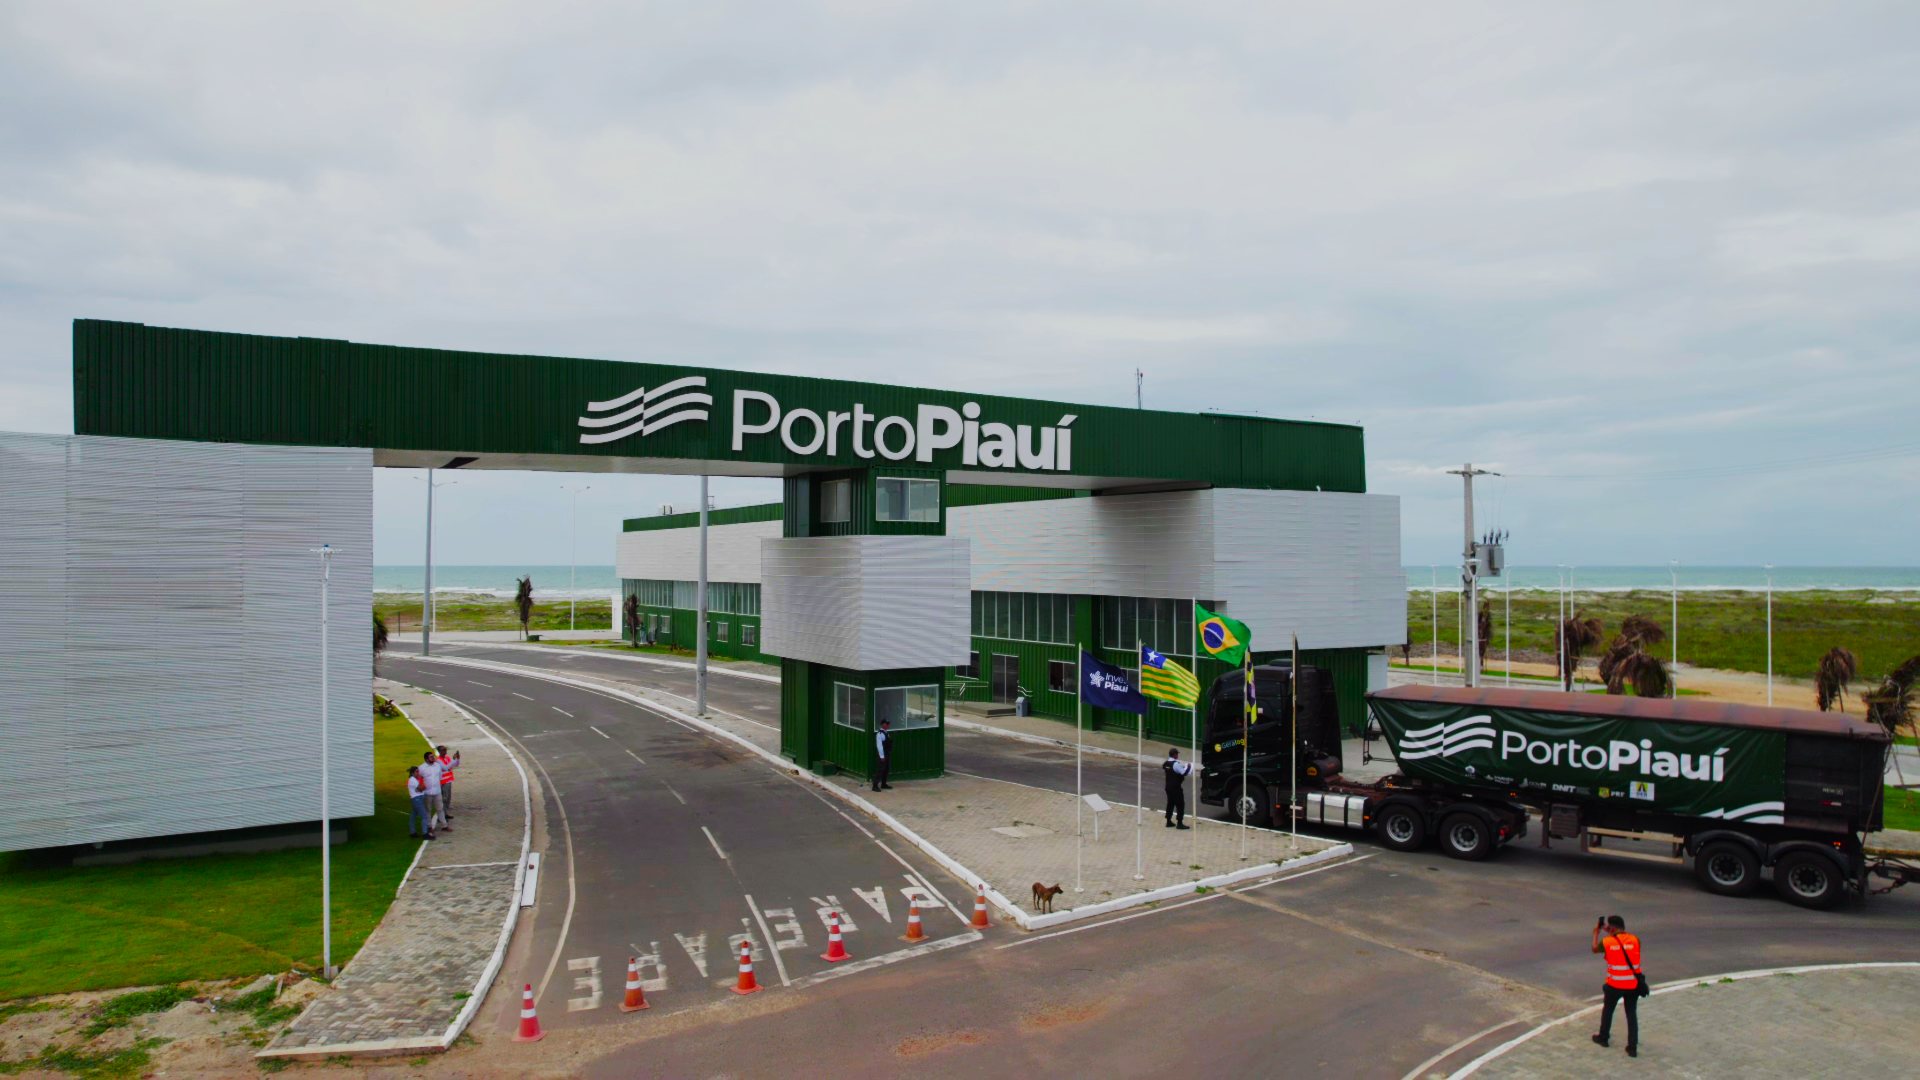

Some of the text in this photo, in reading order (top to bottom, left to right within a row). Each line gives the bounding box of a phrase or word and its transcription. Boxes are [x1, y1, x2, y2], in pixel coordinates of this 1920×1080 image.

[732, 389, 1078, 471] PortoPiauí
[1501, 730, 1730, 783] PortoPiauí
[1552, 783, 1576, 793] DNIT
[764, 874, 946, 950] PARE
[567, 917, 764, 1012] PARE
